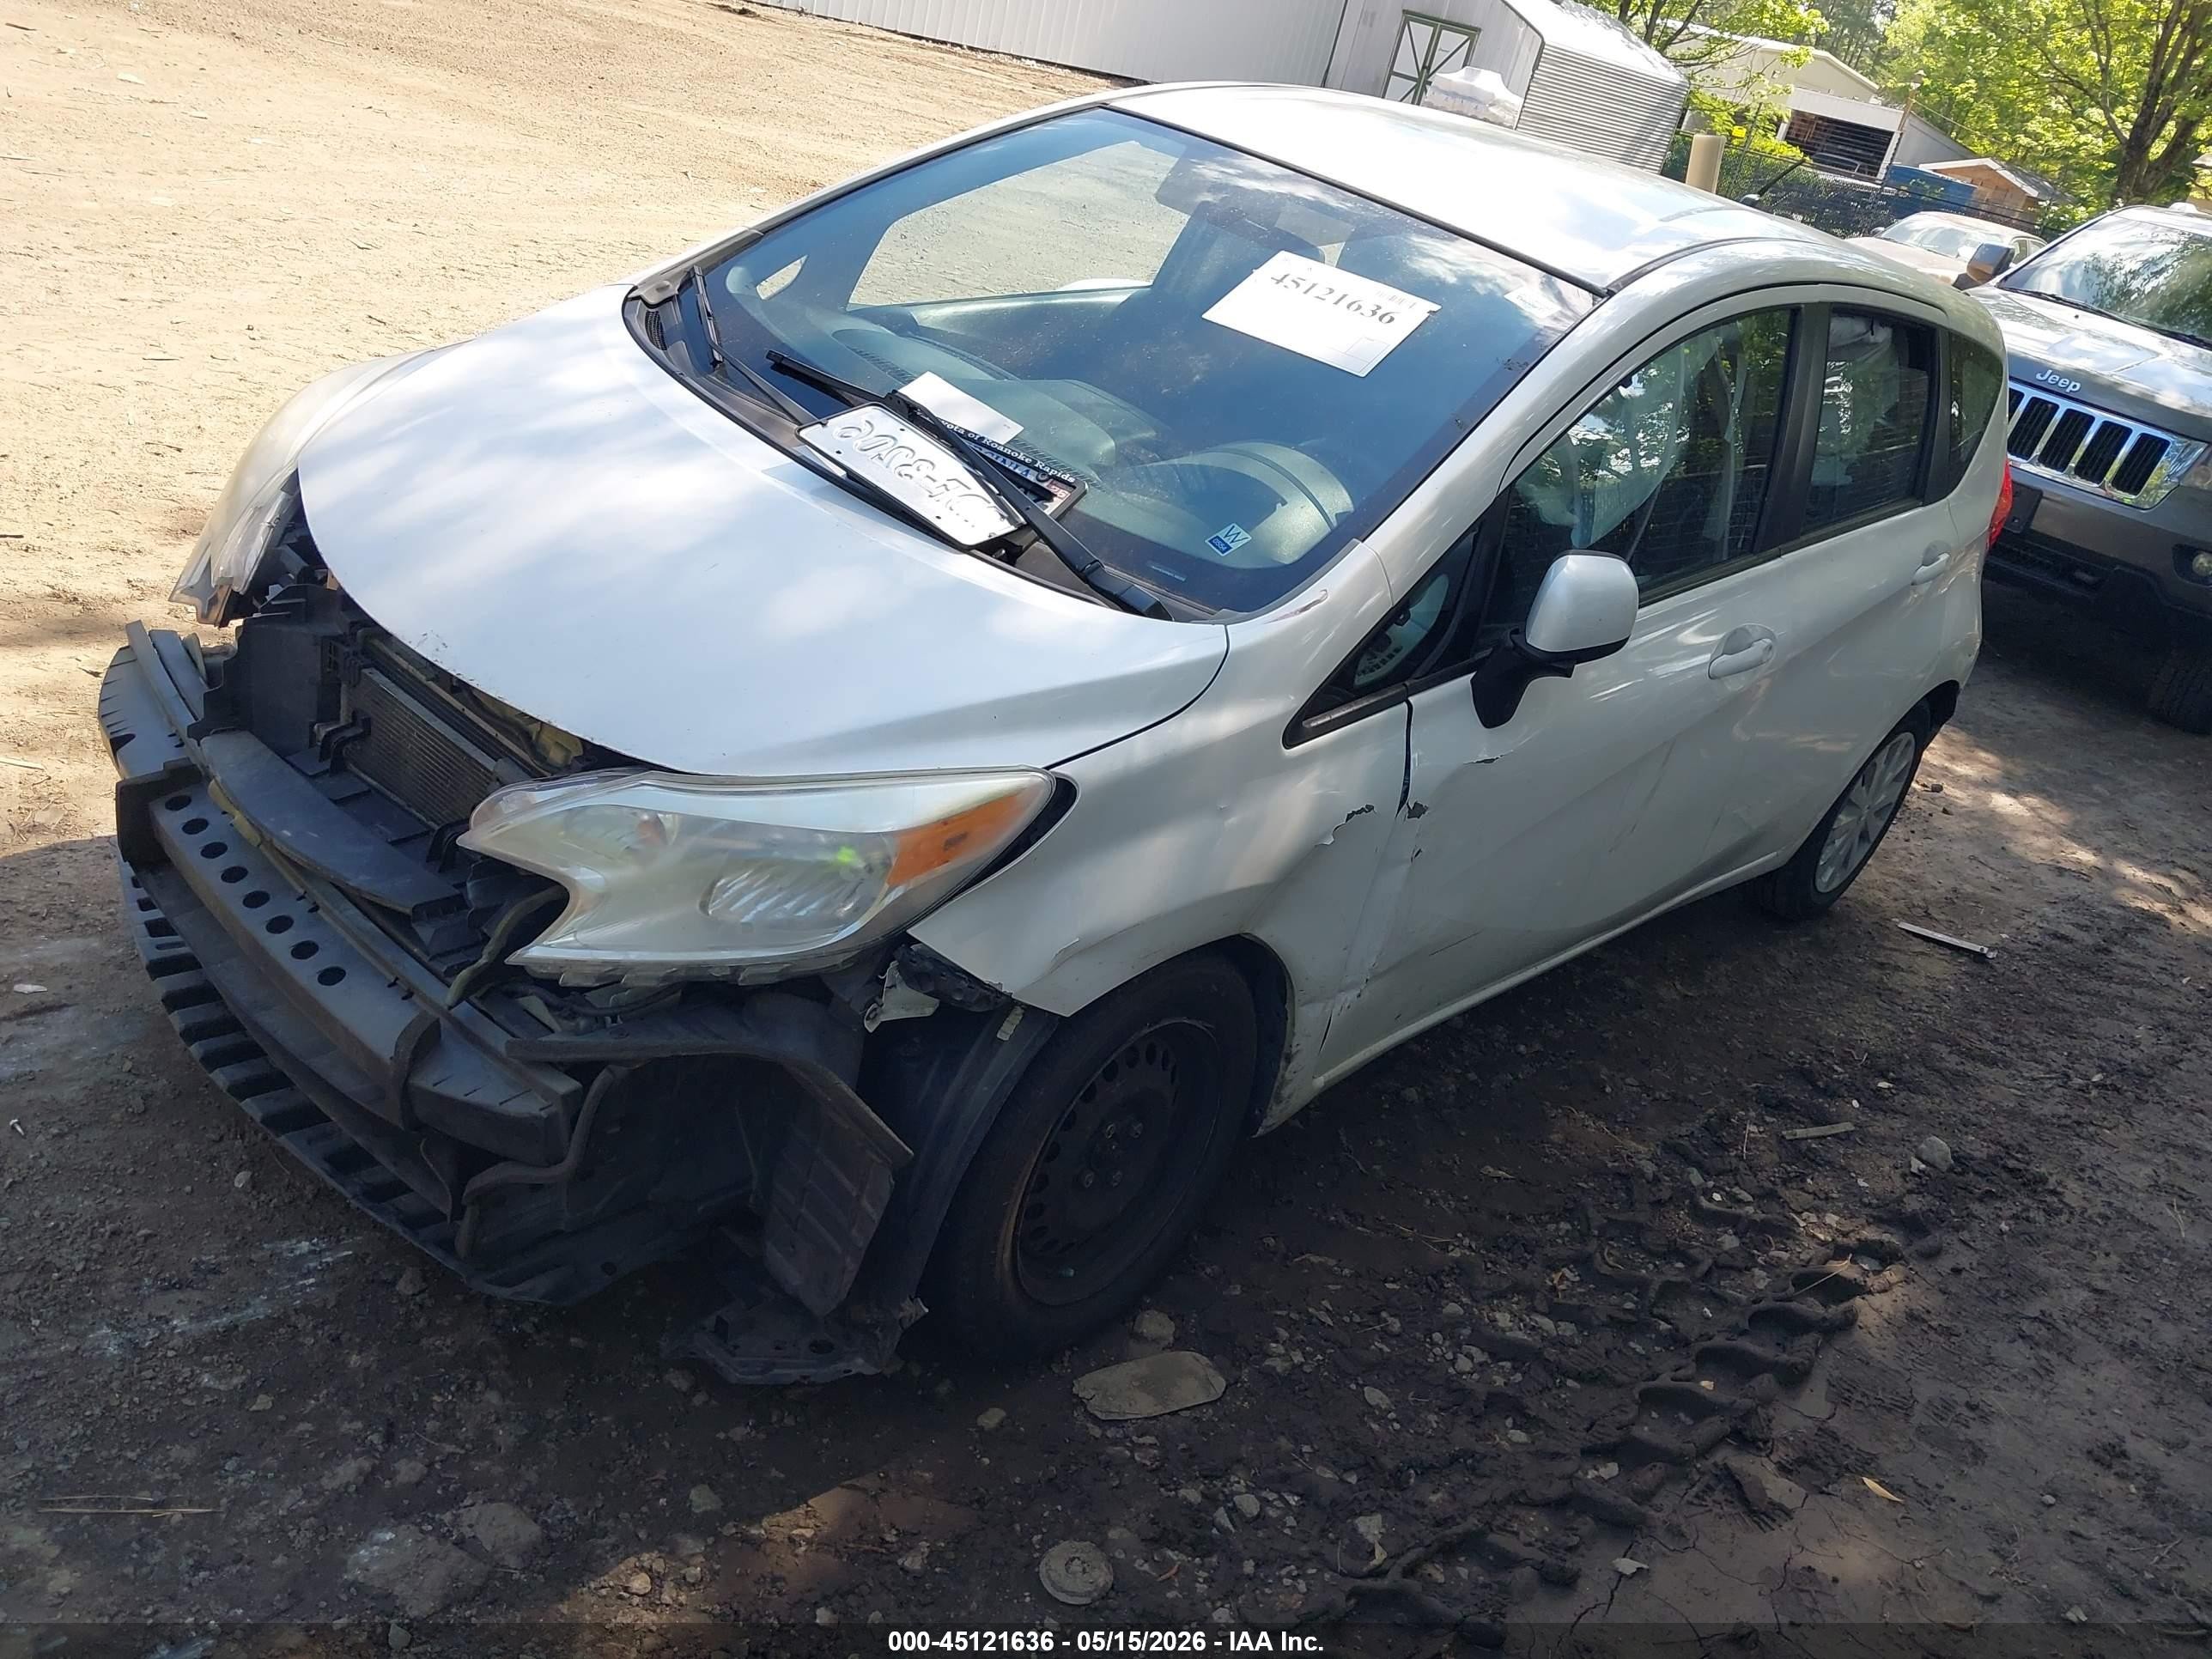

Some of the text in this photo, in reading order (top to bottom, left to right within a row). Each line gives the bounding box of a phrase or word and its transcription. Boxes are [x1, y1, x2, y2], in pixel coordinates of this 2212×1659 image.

[1270, 272, 1400, 325] 45121636
[2035, 369, 2081, 393] Jeep
[968, 432, 980, 441] of
[982, 438, 1032, 464] Roanoke
[1034, 459, 1076, 483] Rapids
[1224, 525, 1249, 544] W
